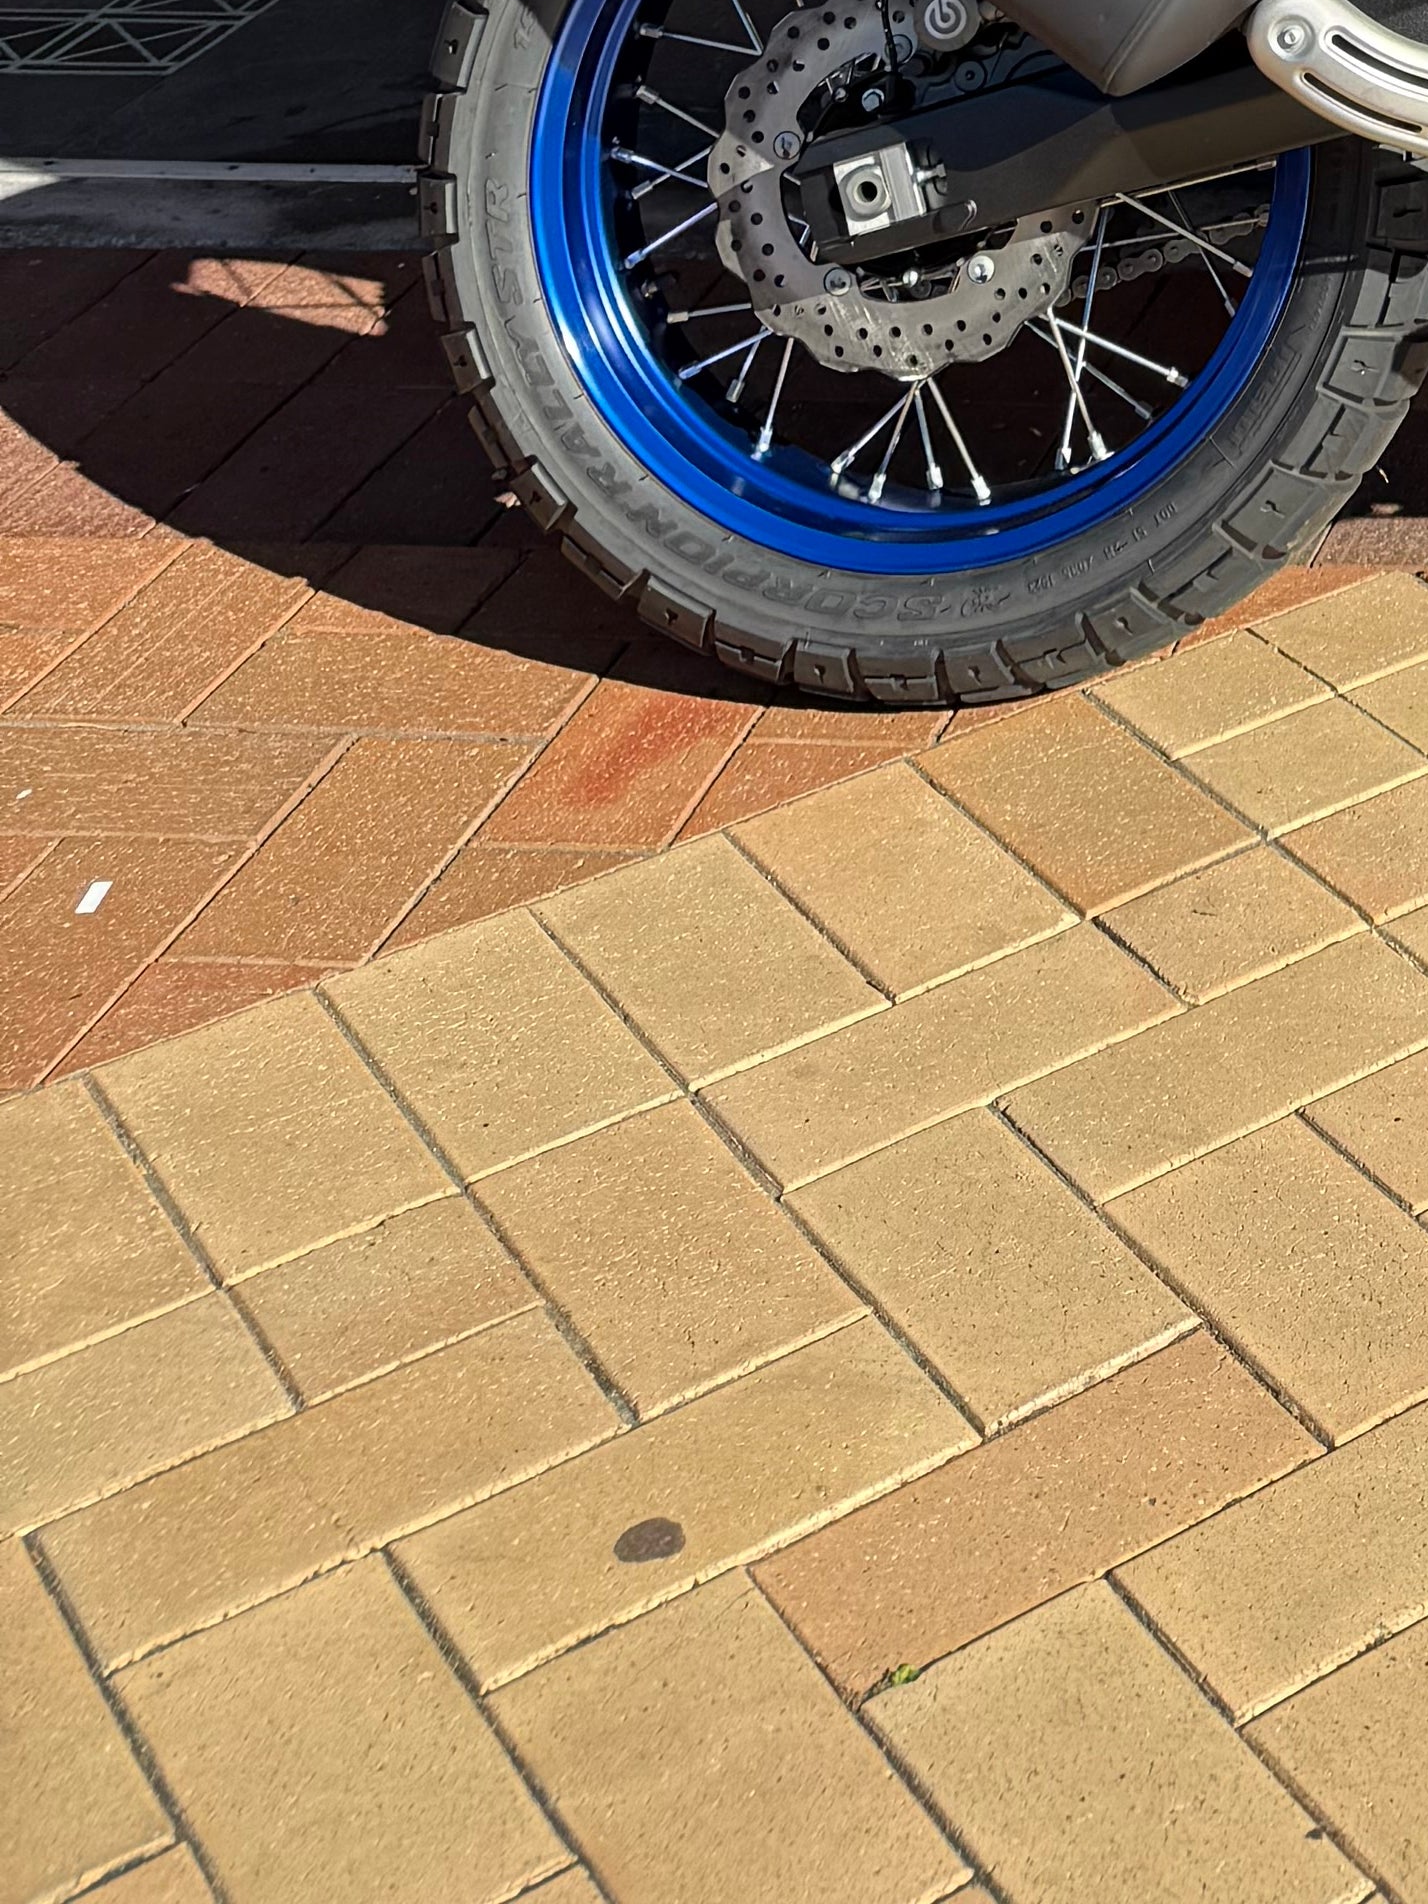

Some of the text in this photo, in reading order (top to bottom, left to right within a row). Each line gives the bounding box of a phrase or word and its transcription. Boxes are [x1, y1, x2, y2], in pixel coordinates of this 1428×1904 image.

[482, 176, 943, 627] SCORPION RALLY STR
